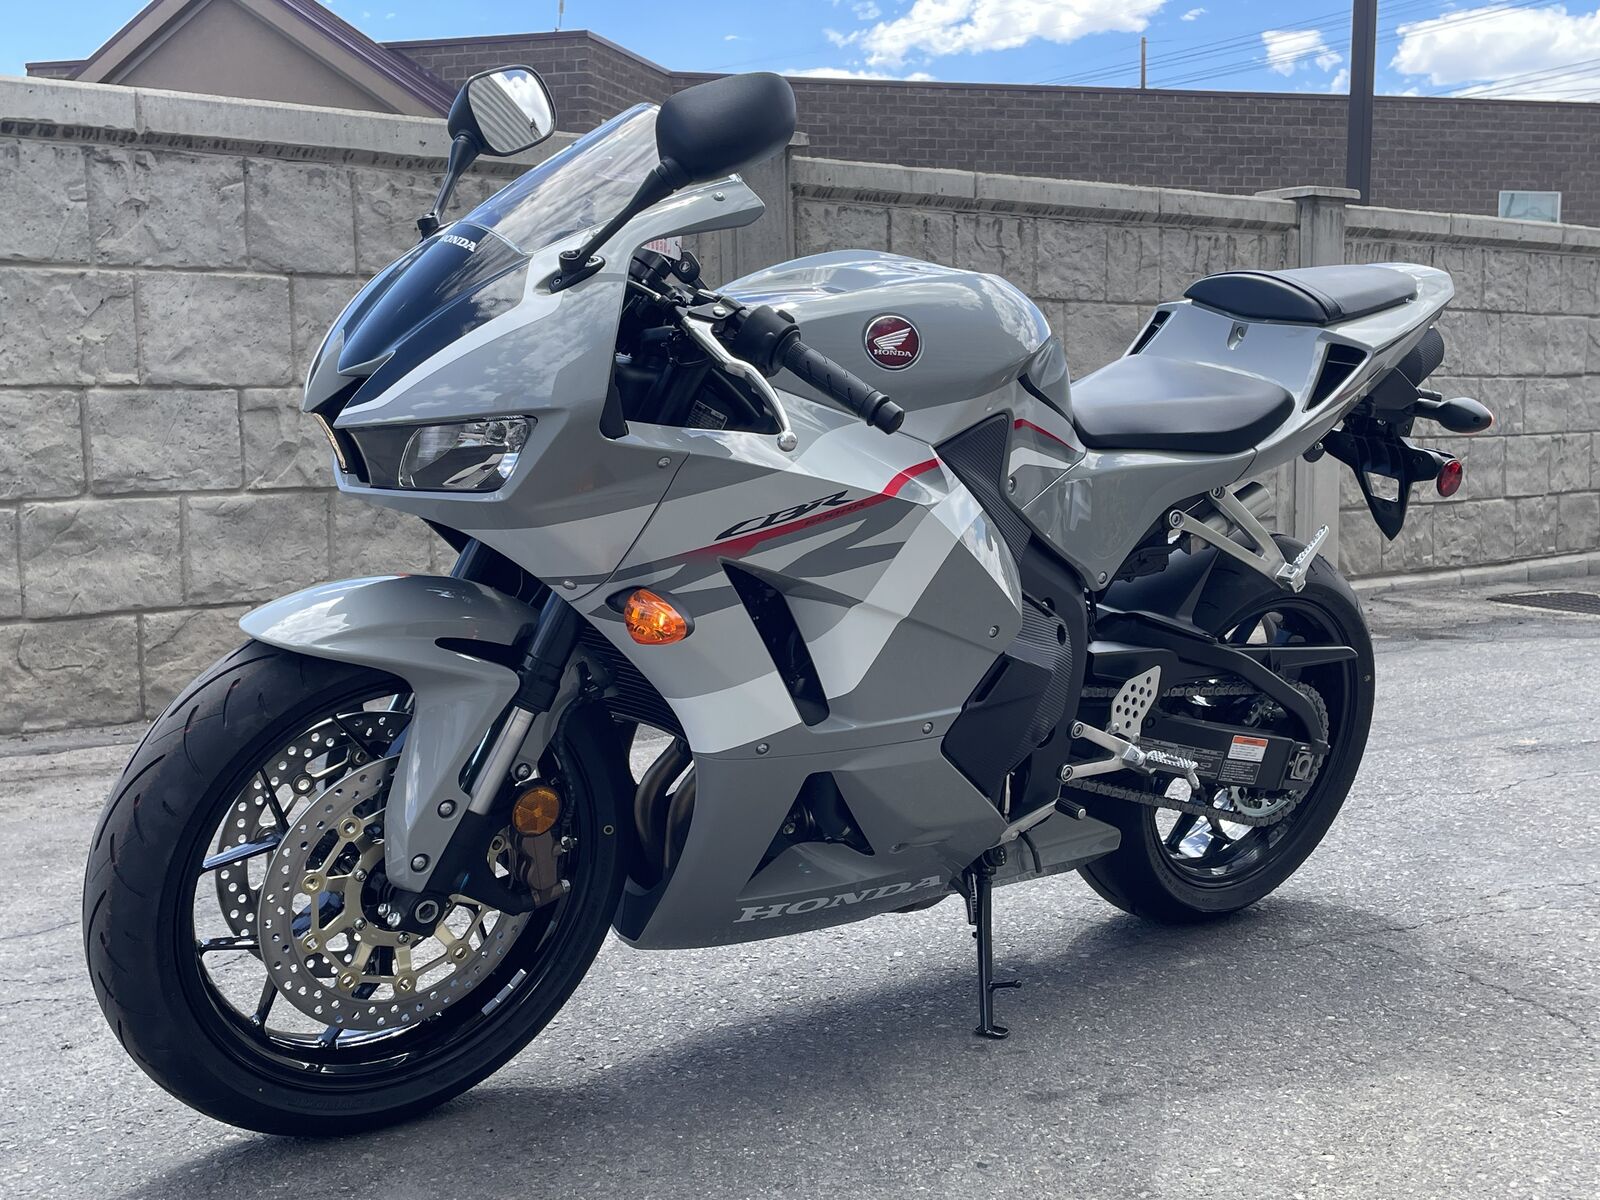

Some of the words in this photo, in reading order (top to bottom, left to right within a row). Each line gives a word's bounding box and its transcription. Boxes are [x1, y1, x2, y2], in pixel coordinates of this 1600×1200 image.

[873, 349, 912, 357] HONDA
[714, 489, 855, 541] CBR
[733, 875, 943, 923] HONDA
